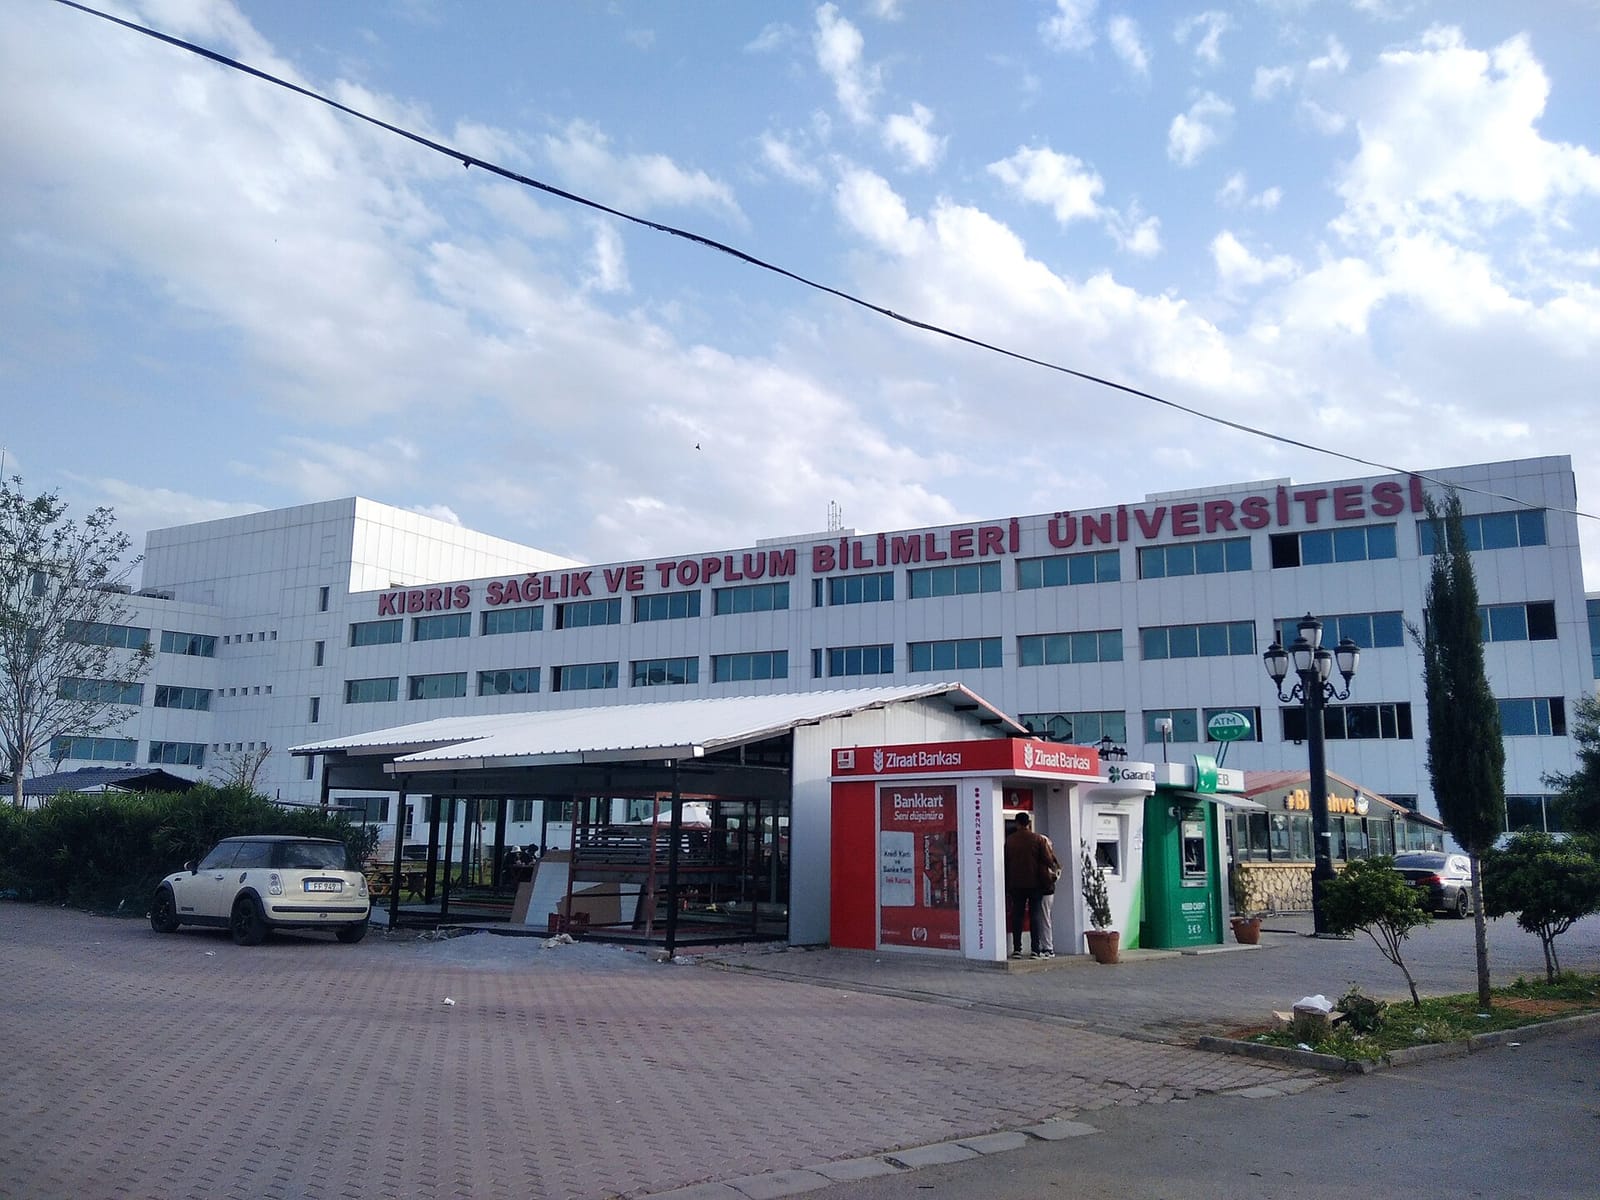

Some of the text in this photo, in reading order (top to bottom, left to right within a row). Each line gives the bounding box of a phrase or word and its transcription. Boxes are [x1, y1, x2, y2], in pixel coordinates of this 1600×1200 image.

[378, 476, 1424, 616] KIBRIS SAĞLIK VE TOPLUM BİLİMLERİ ÜNİVERSİTESİ
[1213, 716, 1237, 727] ATM
[886, 750, 961, 768] Ziraat Bankası
[1034, 749, 1091, 770] Ziraat Bankası
[894, 793, 944, 809] Bankkart
